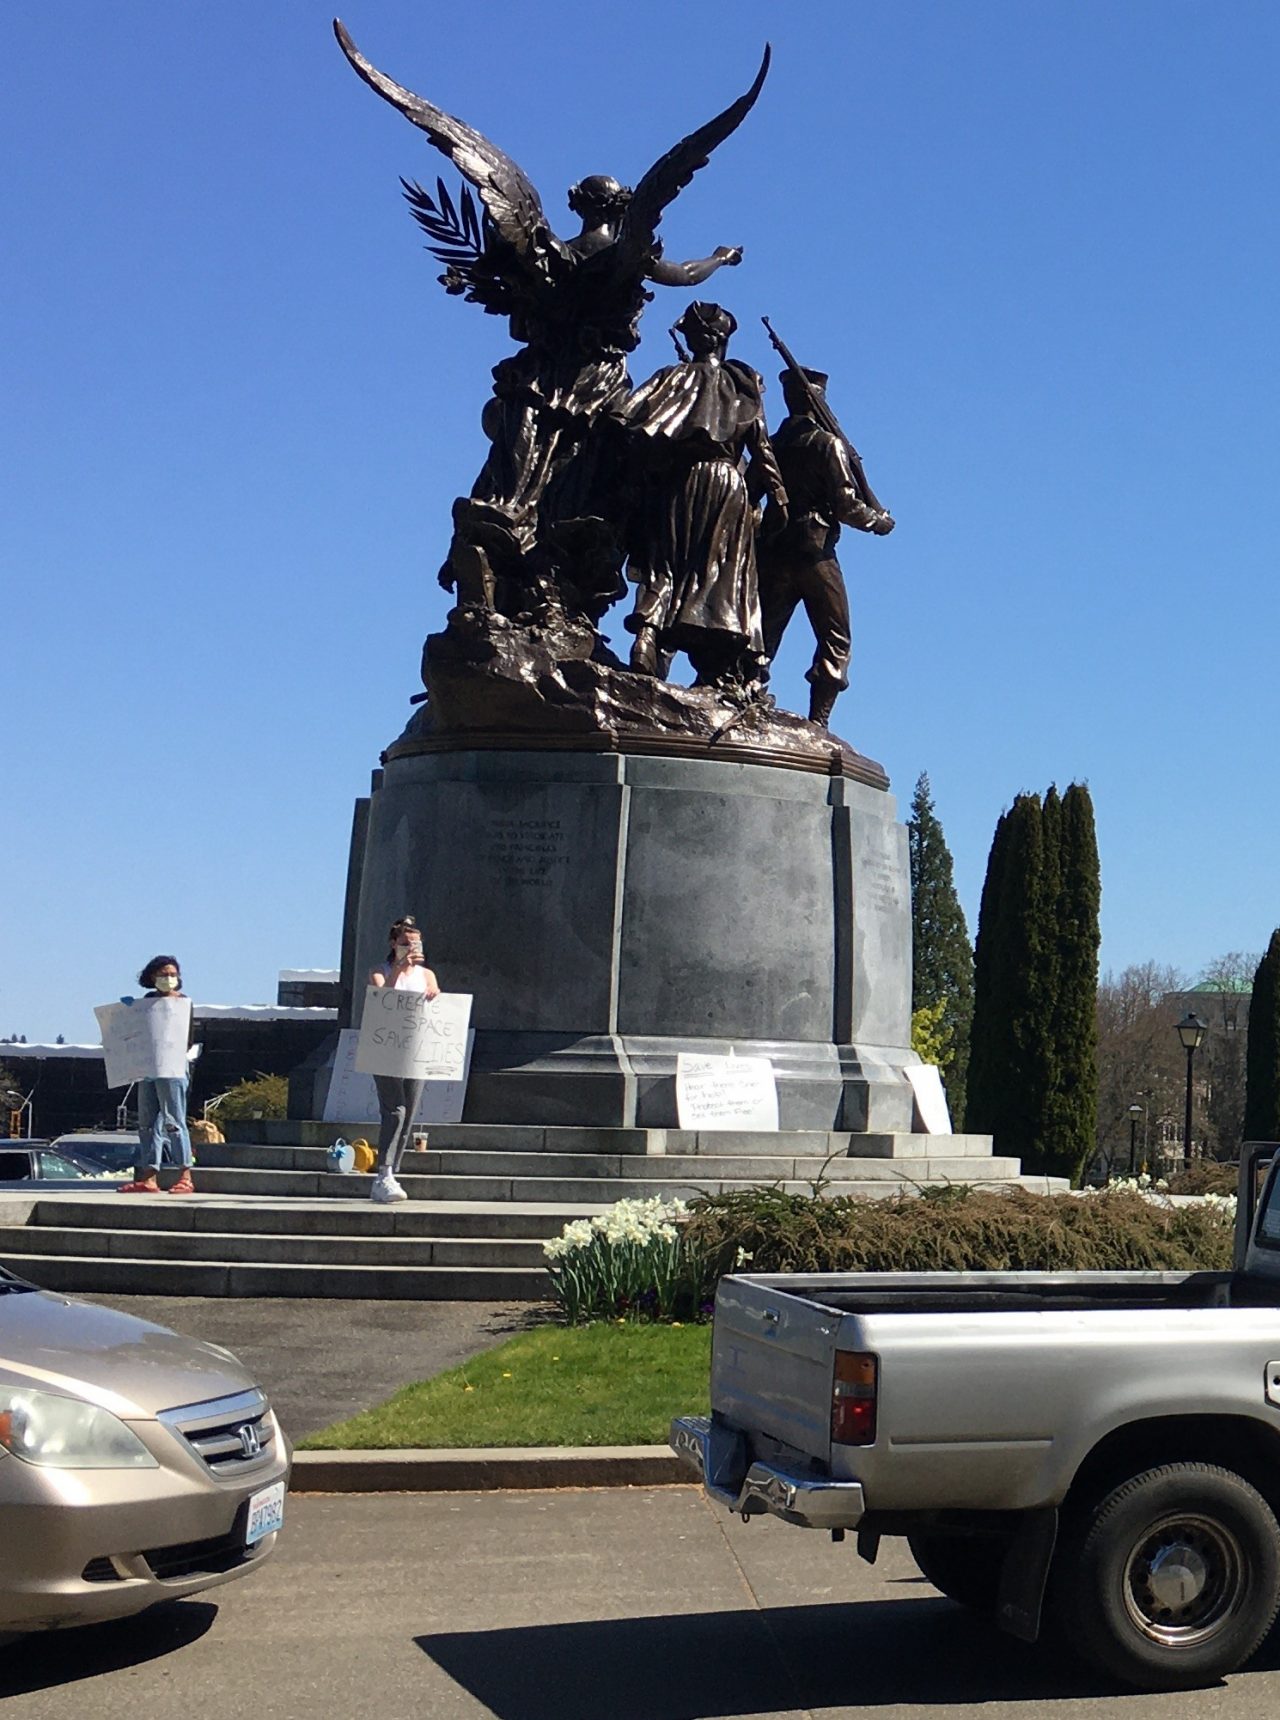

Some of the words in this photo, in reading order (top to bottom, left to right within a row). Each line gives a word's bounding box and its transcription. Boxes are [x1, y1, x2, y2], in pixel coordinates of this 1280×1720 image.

[381, 990, 441, 1014] CREAE
[402, 1015, 455, 1038] SPACE
[372, 1027, 414, 1050] SAVE
